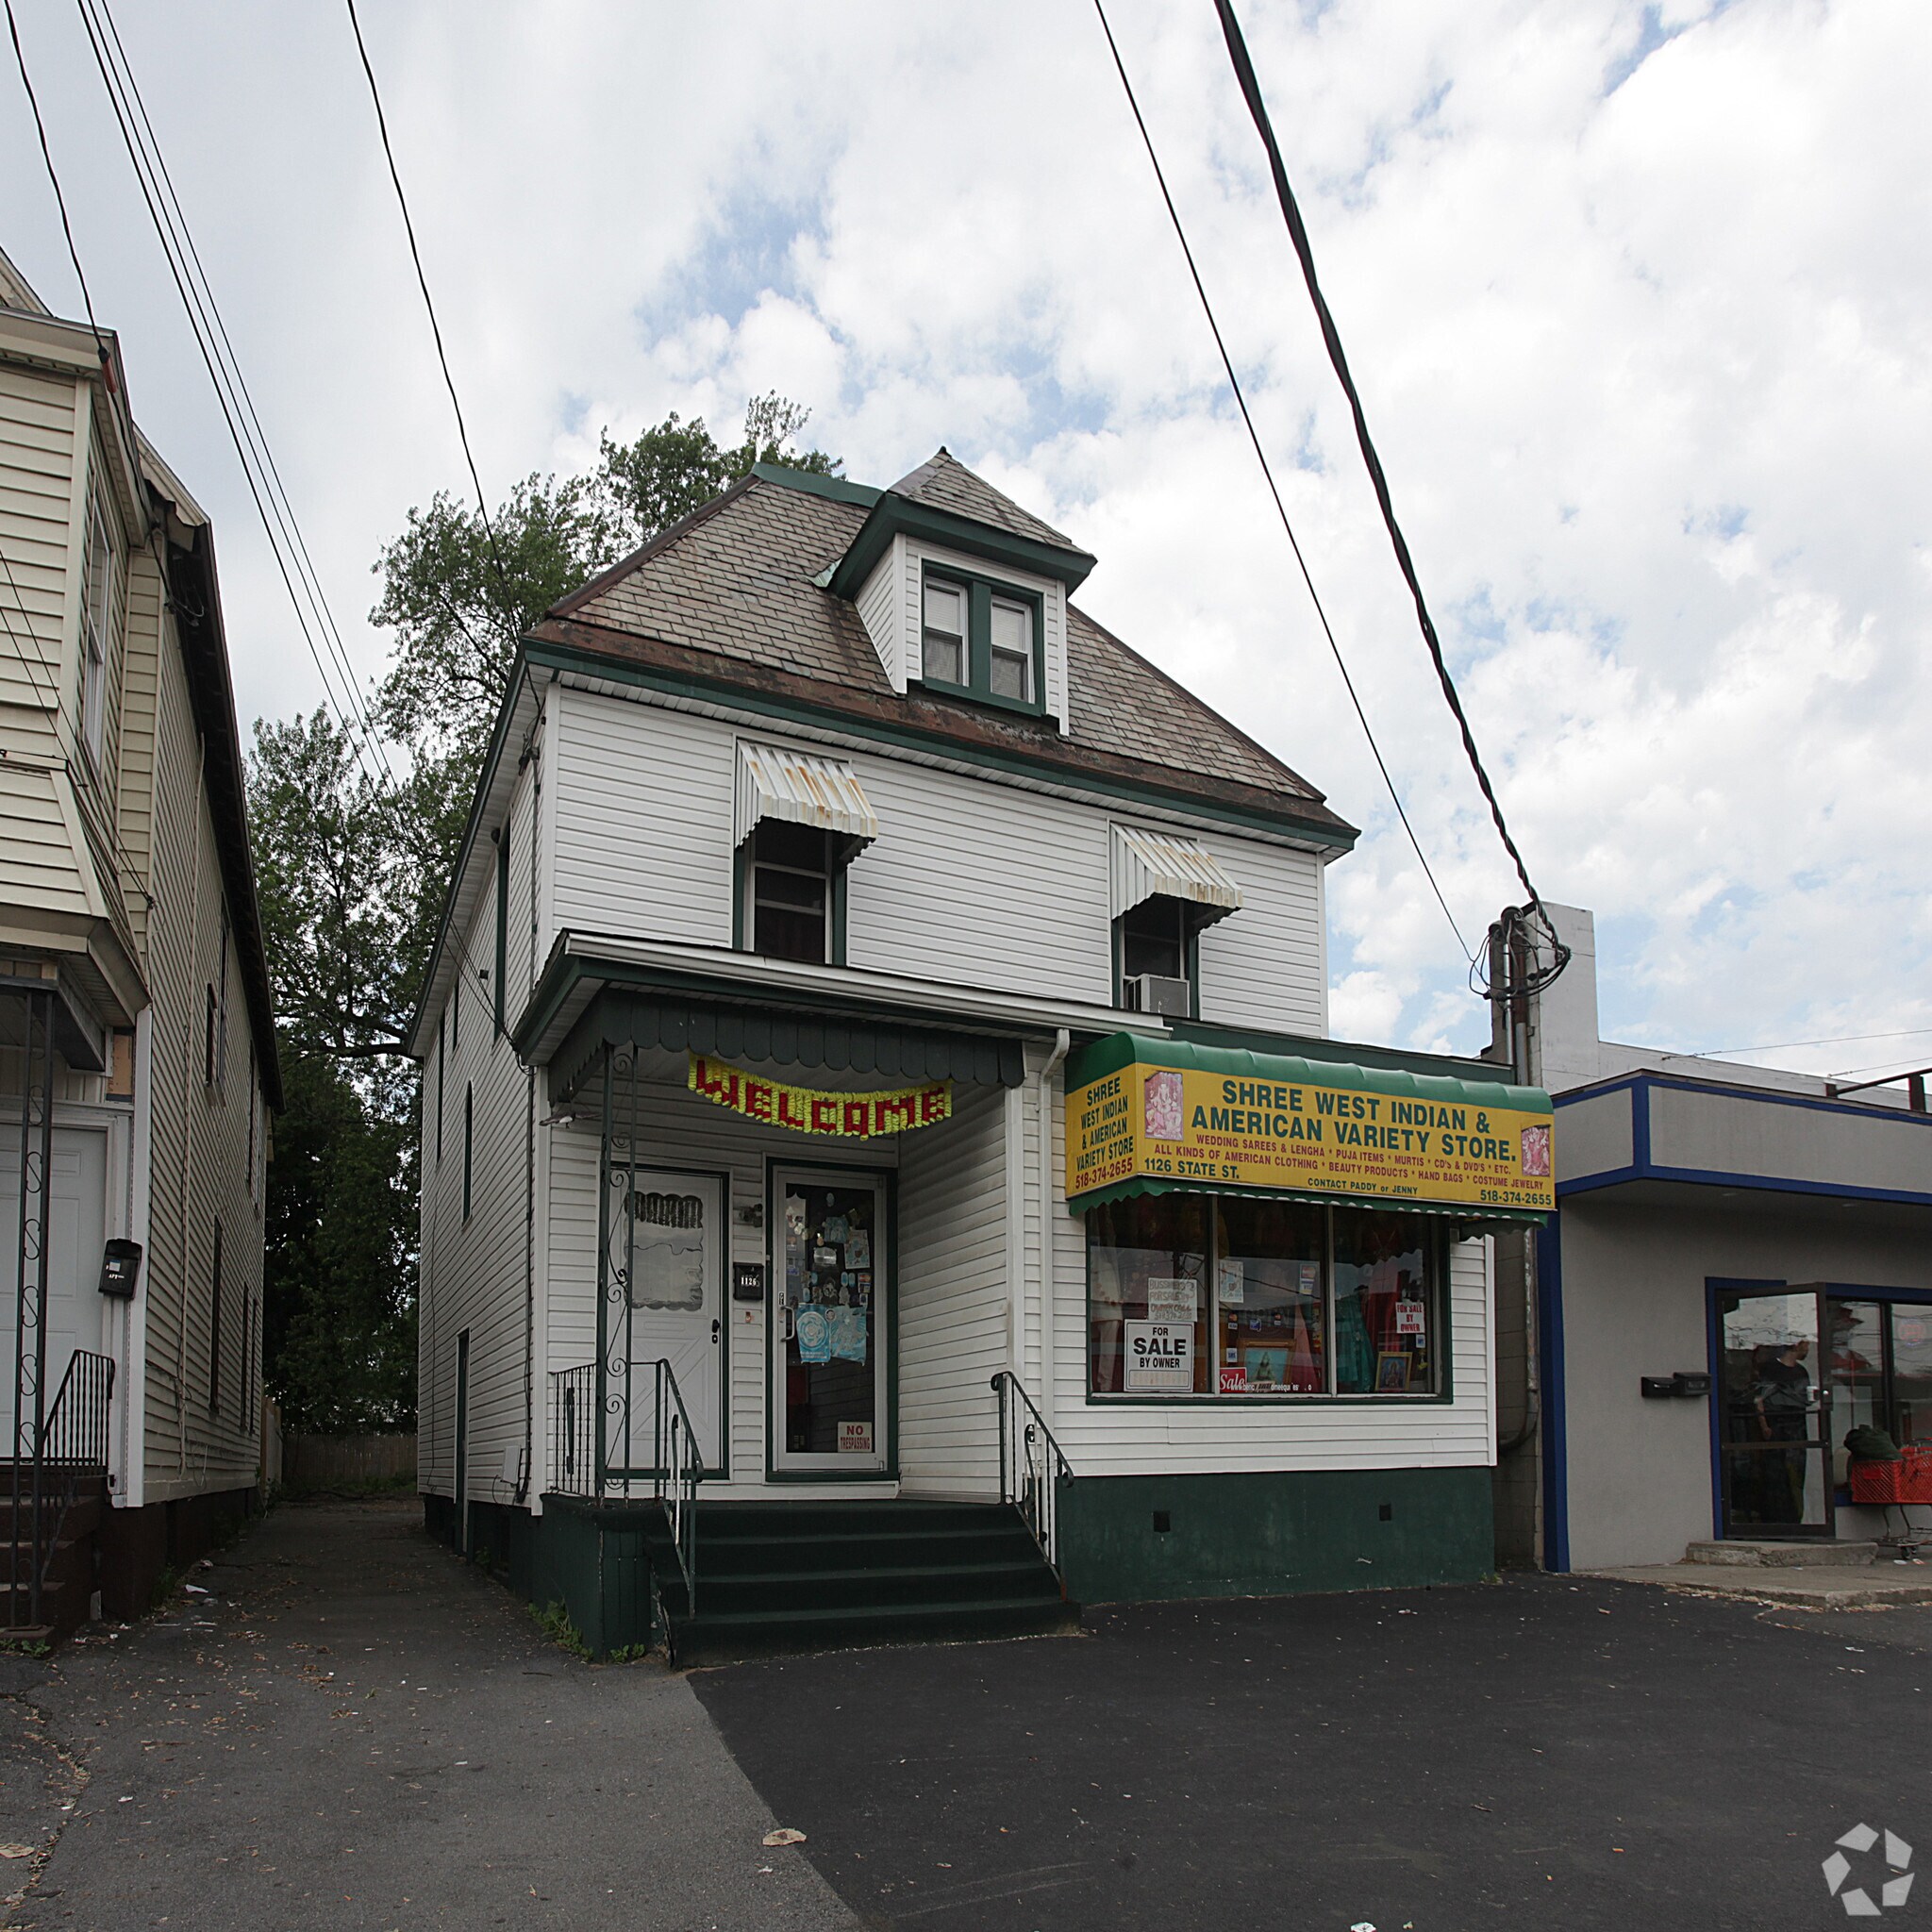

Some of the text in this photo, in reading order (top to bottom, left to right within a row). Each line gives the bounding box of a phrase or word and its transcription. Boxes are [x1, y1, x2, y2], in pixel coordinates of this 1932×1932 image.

[695, 1058, 944, 1136] WELCOME
[1087, 1076, 1121, 1107] SHREE
[1080, 1095, 1128, 1130] WEST INDIAN
[1223, 1080, 1491, 1134] SHREE WEST INDIAN &
[1082, 1117, 1127, 1150] & AMERICAN
[1191, 1106, 1516, 1162] AMERICAN VARIETY STORE.
[1076, 1136, 1134, 1172] VARIETY STORE
[1196, 1134, 1239, 1148] WEDDING
[1242, 1140, 1276, 1152] SAREES
[1280, 1144, 1287, 1154] &
[1291, 1145, 1324, 1157] LENGHA
[1336, 1150, 1357, 1160] PUJA
[1359, 1152, 1385, 1163] ITEMS
[1394, 1155, 1424, 1167] MURTIS
[1455, 1160, 1460, 1170] &
[1494, 1165, 1511, 1174] ETC.
[1075, 1158, 1133, 1190] 518-374-2655
[1144, 1158, 1240, 1179] 1126 STATE ST.
[1154, 1143, 1543, 1191] ALL KINDS OF AMERICAN CLOTHING BEAUTY PRODUCTS HAND BAGS COSTUME JEWELRY
[1307, 1177, 1346, 1189] CONTACT
[1350, 1181, 1376, 1191] PADDY
[1391, 1185, 1418, 1195] JENNY
[1480, 1190, 1552, 1206] 518-374-2655
[741, 1275, 757, 1286] 1126
[1397, 1304, 1422, 1313] FOR SALE
[1152, 1327, 1169, 1336] FOR
[1400, 1323, 1420, 1332] OWNER
[1133, 1337, 1187, 1356] SALE
[1140, 1357, 1180, 1369] BY OWNER
[1220, 1374, 1245, 1390] Sale
[846, 1425, 864, 1436] NO
[840, 1437, 871, 1450] TRESPASSING
